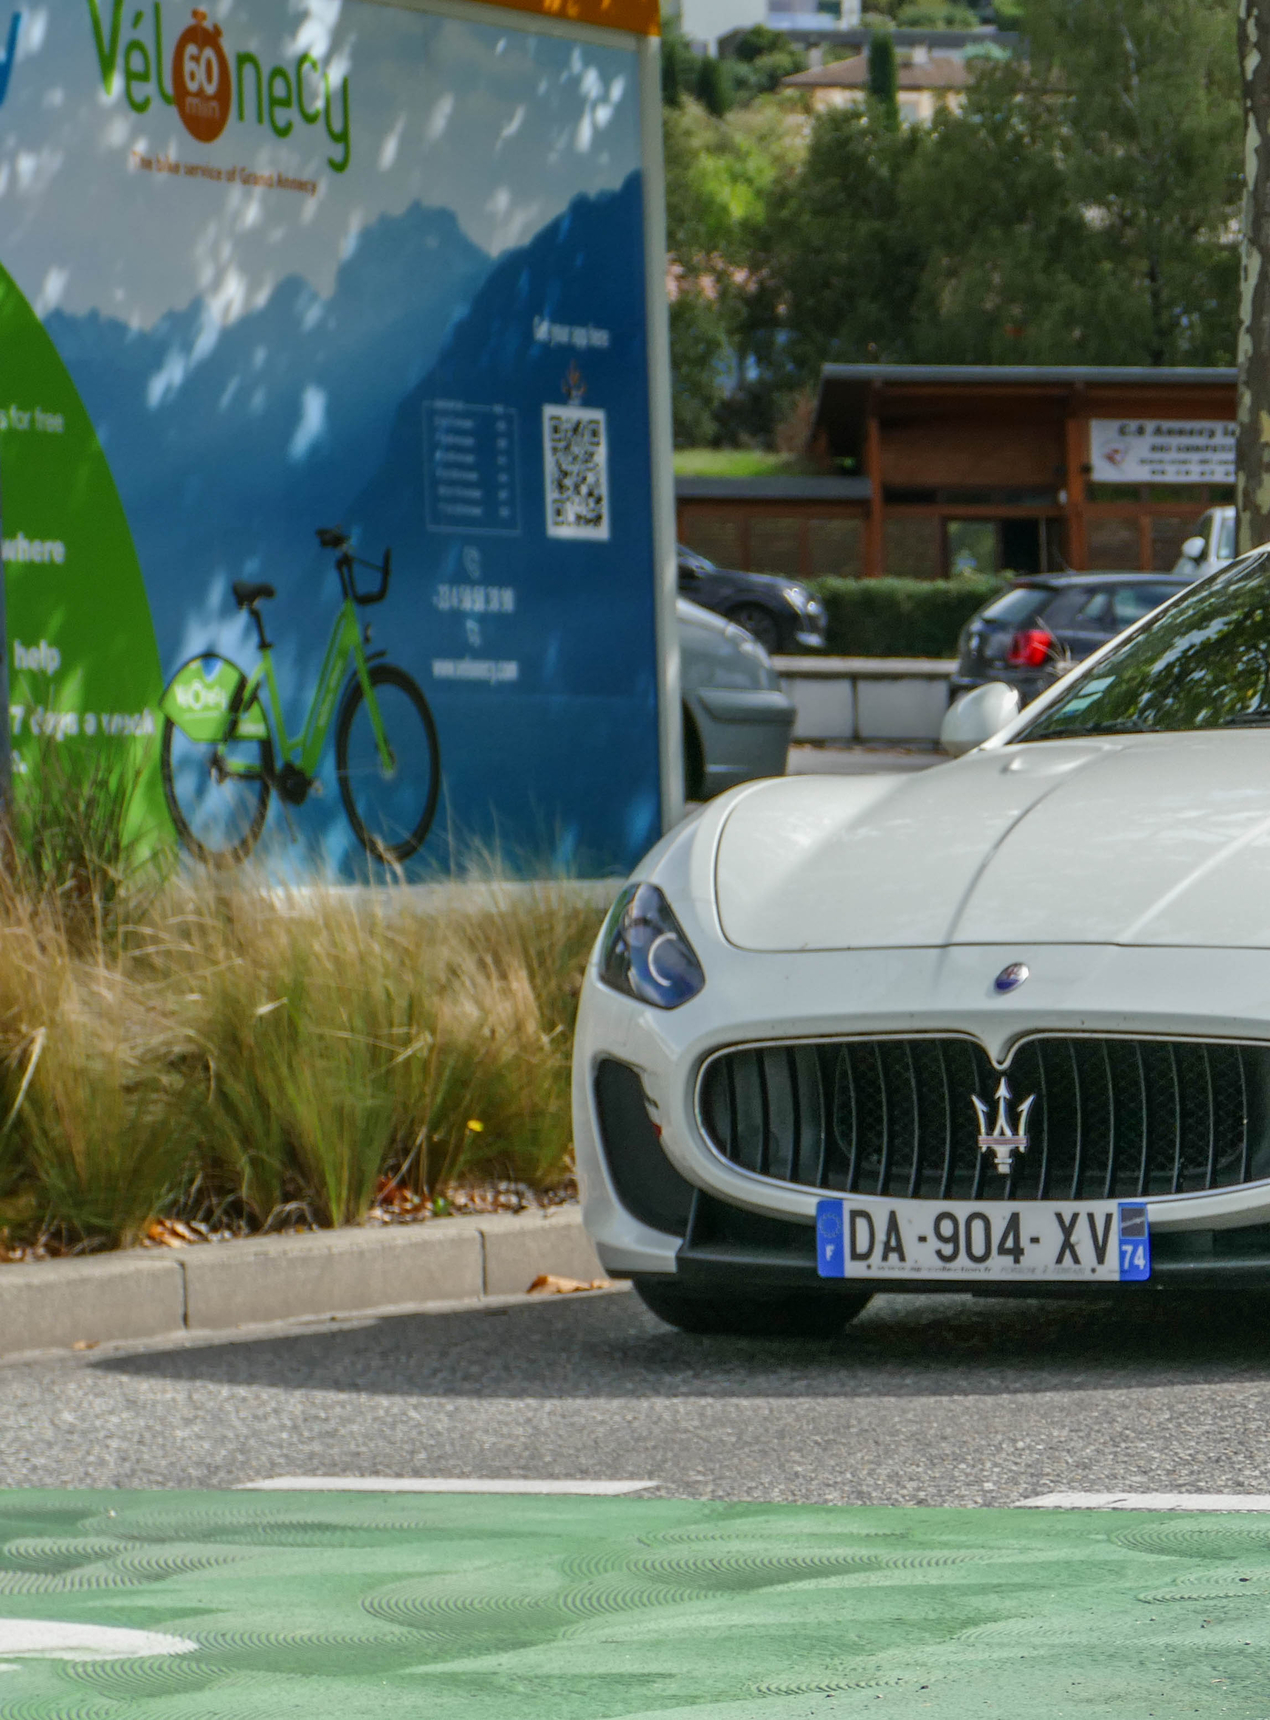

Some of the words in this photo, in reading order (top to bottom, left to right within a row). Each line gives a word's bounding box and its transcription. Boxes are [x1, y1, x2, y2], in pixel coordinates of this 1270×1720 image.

[183, 43, 220, 96] 60
[185, 96, 221, 120] min
[9, 403, 32, 431] for
[34, 405, 65, 434] free
[13, 638, 62, 677] help
[824, 1245, 835, 1262] F
[848, 1209, 1114, 1266] DA-904-XV
[1121, 1244, 1146, 1270] 74
